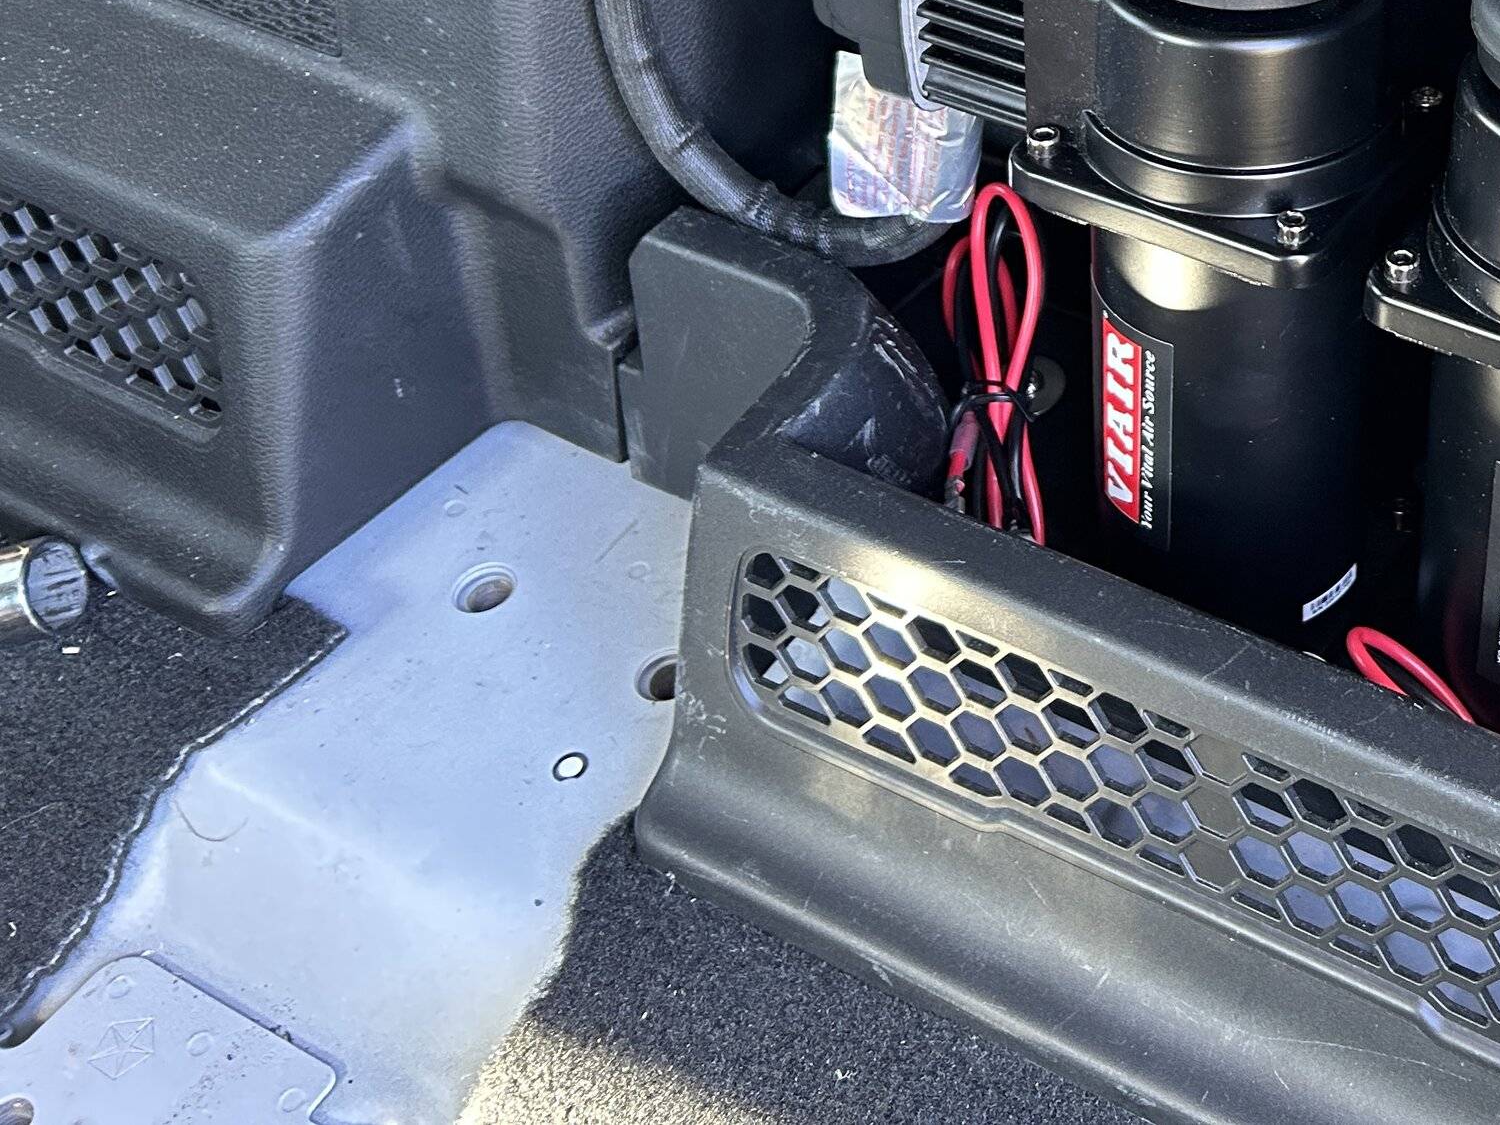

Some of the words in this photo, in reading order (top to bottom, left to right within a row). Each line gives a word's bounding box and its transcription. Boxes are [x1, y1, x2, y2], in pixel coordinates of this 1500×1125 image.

[1142, 349, 1155, 415] Source
[1106, 332, 1134, 503] VIAIR
[1142, 416, 1155, 446] Air
[1141, 445, 1154, 489] Vital
[1140, 492, 1153, 529] Your
